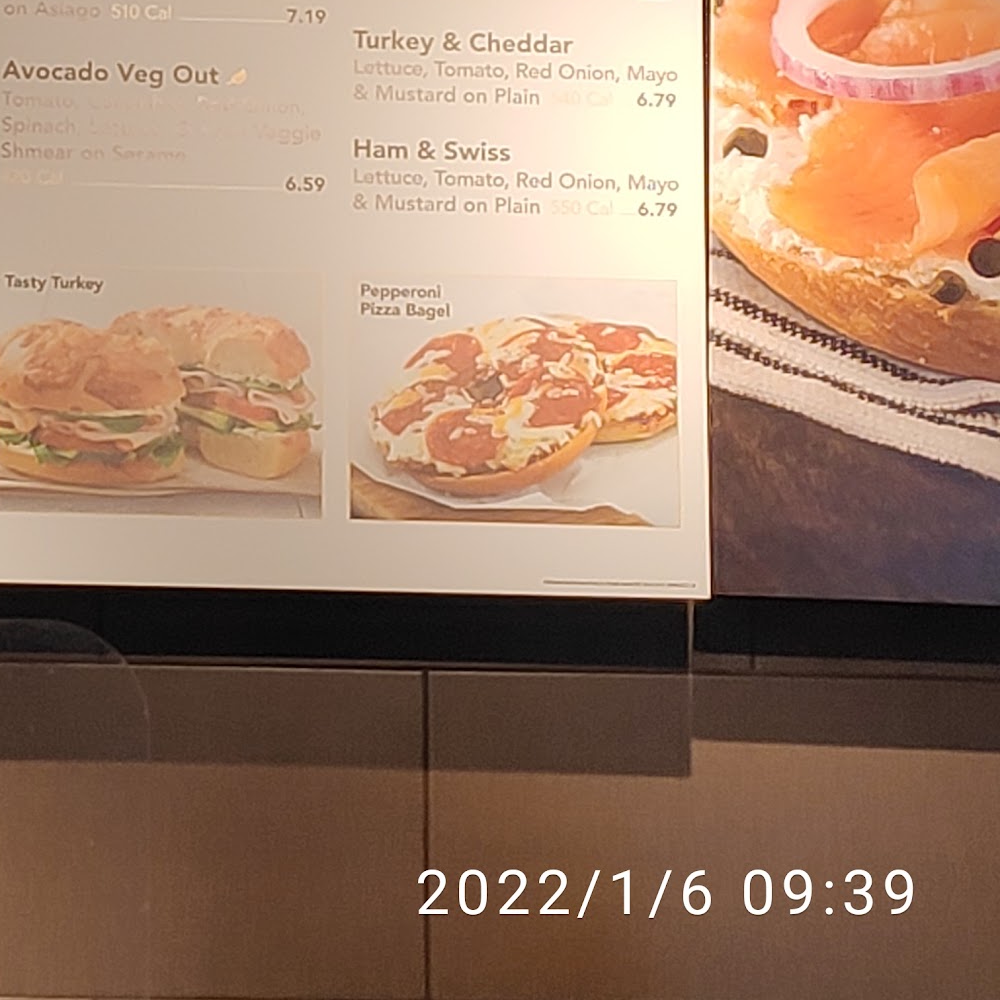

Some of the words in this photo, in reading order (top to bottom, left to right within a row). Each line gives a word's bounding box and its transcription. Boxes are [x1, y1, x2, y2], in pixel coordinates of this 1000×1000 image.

[286, 8, 327, 25] 7.19
[353, 29, 435, 57] Turkey
[442, 32, 462, 52] &
[469, 32, 574, 55] Cheddar
[2, 60, 109, 83] Avocado
[117, 63, 164, 89] Veg
[173, 65, 220, 85] Out
[353, 59, 429, 79] Lettuce,
[434, 60, 510, 81] Tomato,
[516, 62, 553, 80] Red
[558, 63, 620, 84] Onion,
[627, 65, 679, 87] Mayo
[353, 84, 369, 101] &
[375, 84, 457, 104] Mustard
[462, 90, 488, 104] on
[494, 87, 540, 106] Plain
[636, 92, 677, 108] 6.79
[353, 138, 409, 160] Ham
[417, 140, 436, 161] &
[443, 140, 512, 163] Swiss
[285, 176, 326, 192] 6.59
[637, 203, 677, 217] 6.79
[4, 274, 47, 292] Tasty
[51, 275, 104, 295] Turkey
[360, 283, 442, 301] Pepperoni
[360, 302, 401, 318] Pizza
[405, 303, 451, 321] Bagel
